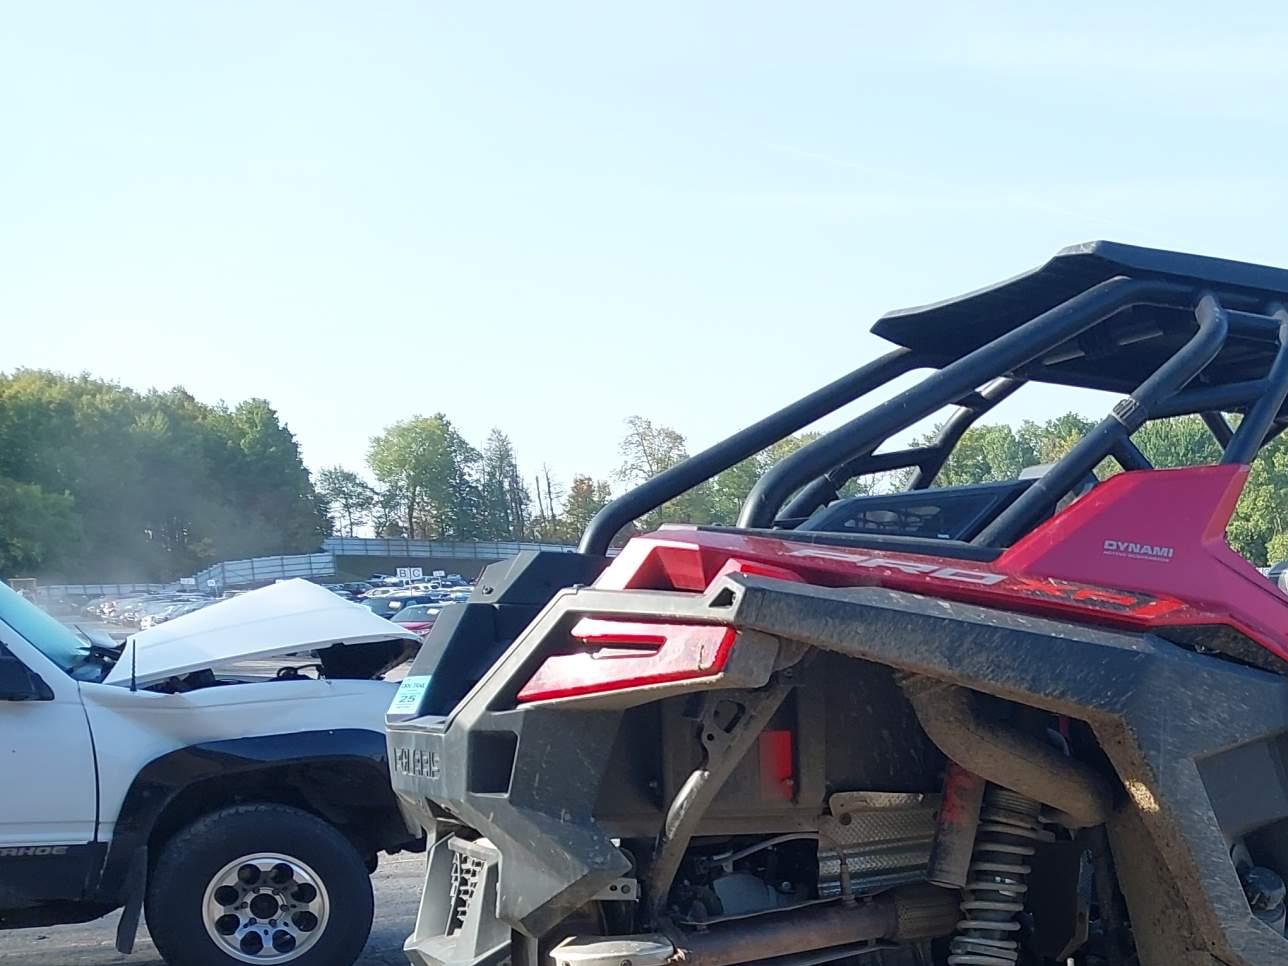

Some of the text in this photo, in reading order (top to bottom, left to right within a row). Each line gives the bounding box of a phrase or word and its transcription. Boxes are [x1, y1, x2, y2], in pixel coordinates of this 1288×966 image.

[1103, 540, 1174, 557] DYNAMI
[782, 547, 1008, 586] PRO
[0, 846, 67, 857] AHOE
